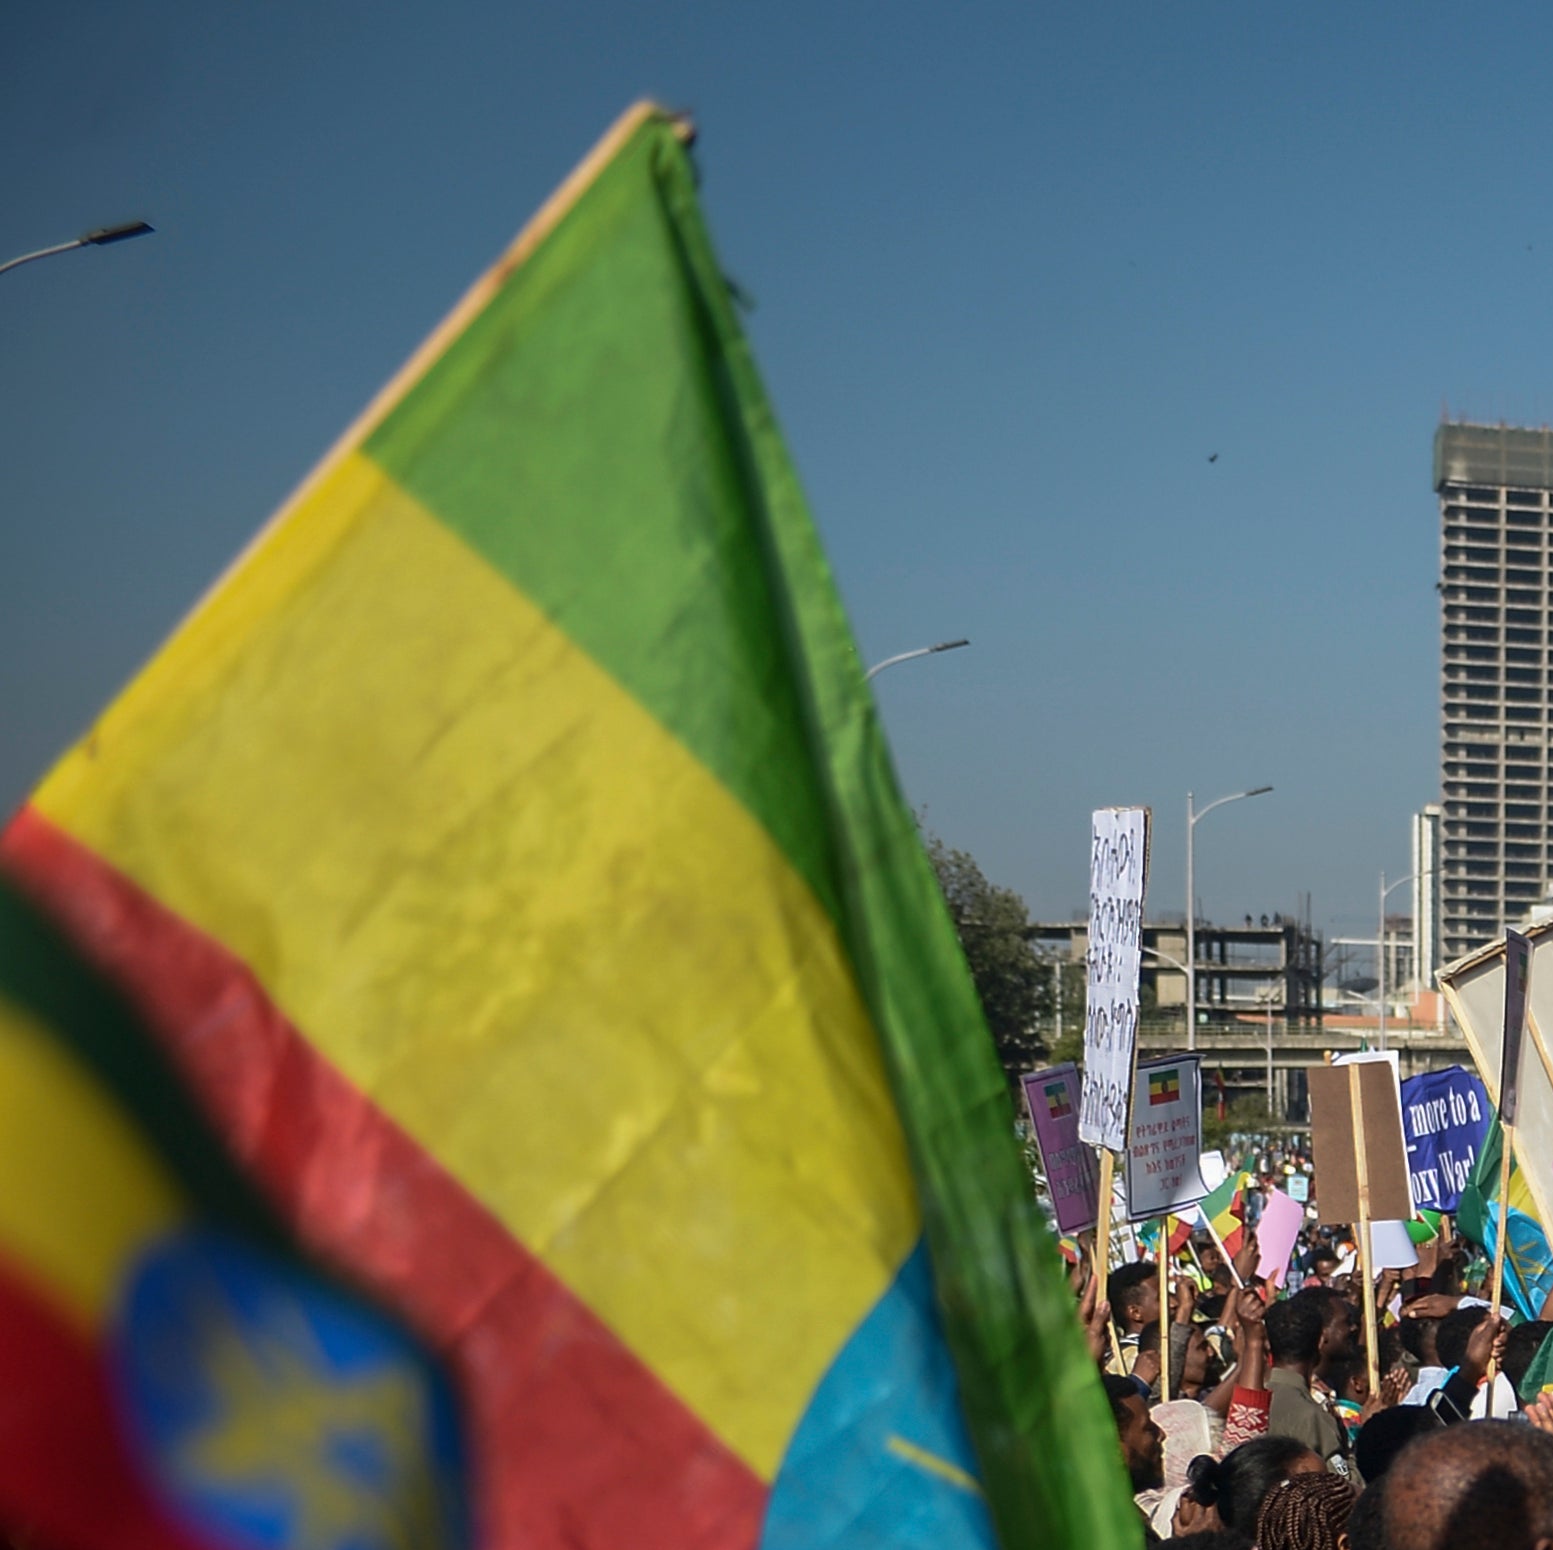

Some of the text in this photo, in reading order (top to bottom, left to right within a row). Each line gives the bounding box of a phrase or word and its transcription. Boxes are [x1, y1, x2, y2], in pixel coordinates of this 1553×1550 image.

[1409, 1086, 1481, 1137] more to a
[1411, 1168, 1442, 1210] oxy
